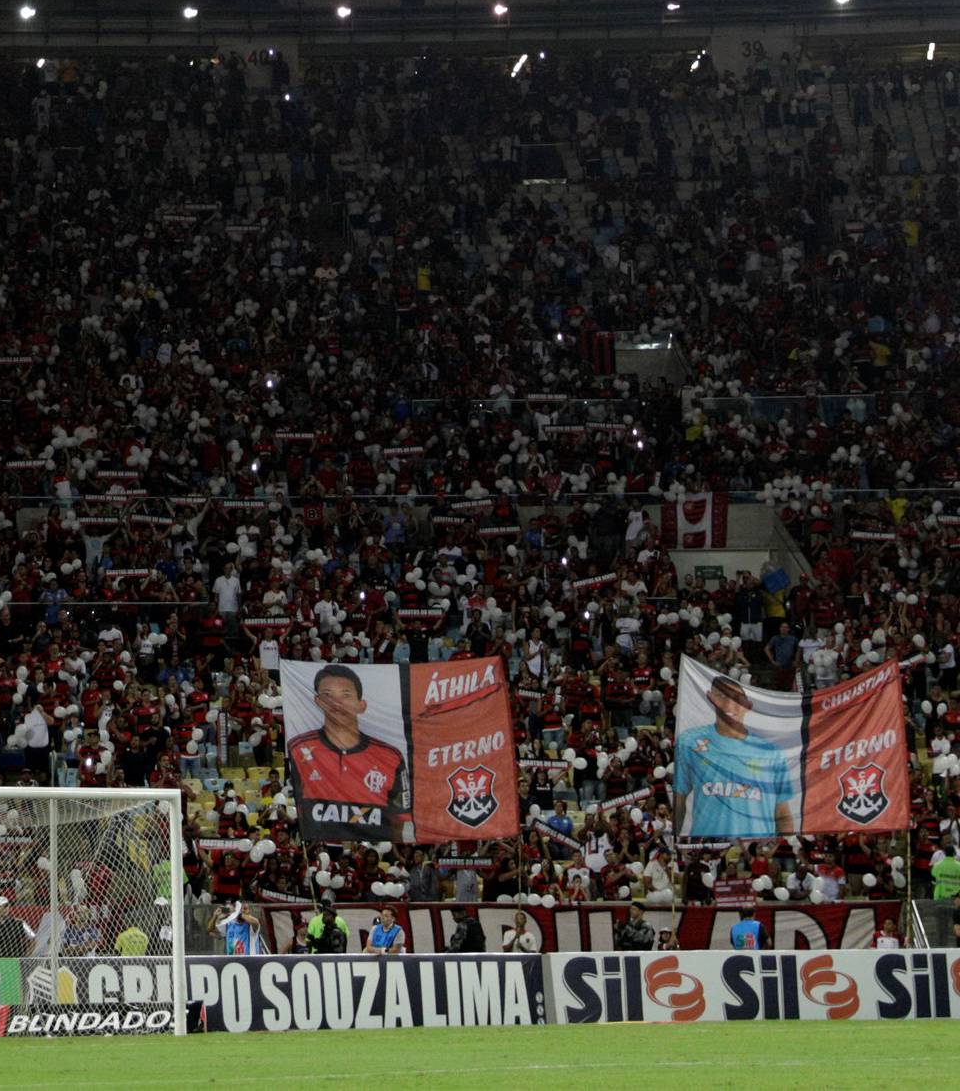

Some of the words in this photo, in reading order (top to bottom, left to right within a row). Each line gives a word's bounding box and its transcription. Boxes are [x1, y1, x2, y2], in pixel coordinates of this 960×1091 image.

[424, 664, 496, 705] ÁTHILA
[428, 731, 505, 768] ETERNO
[819, 729, 897, 771] ETERNO
[702, 781, 761, 801] CAIXA
[312, 803, 382, 826] CAIXA
[260, 961, 414, 1032] SOUZA
[419, 960, 533, 1027] LIMA
[562, 956, 644, 1025] Sil
[721, 954, 800, 1021] Sil
[874, 953, 952, 1020] Sil
